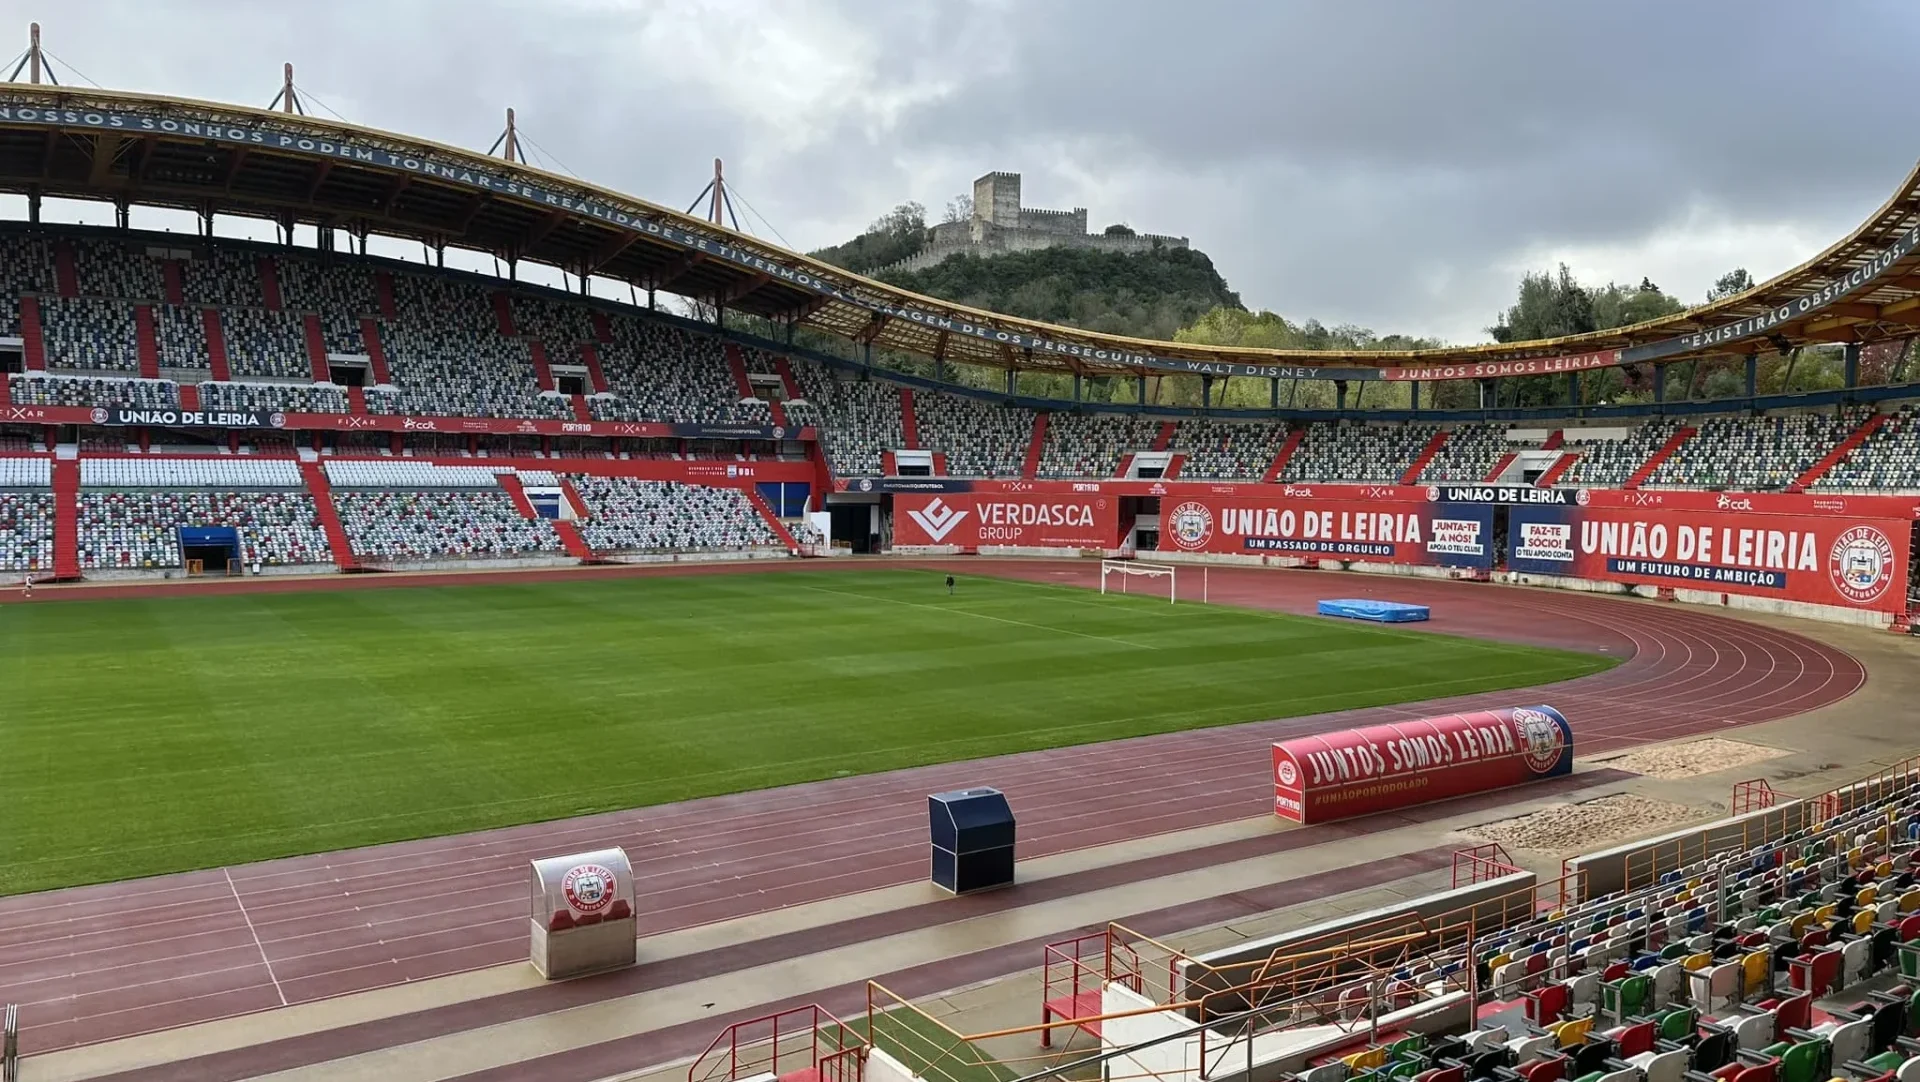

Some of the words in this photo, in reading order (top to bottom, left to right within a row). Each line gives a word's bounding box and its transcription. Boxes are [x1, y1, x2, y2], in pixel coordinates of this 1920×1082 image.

[142, 117, 262, 142] SONHOS
[280, 135, 373, 162] PODEM
[388, 154, 532, 198] TORNAR-SE
[545, 194, 673, 239] REALIDADE
[684, 237, 707, 250] SE
[718, 247, 822, 291] TIVERMOS
[962, 324, 985, 336] DE
[996, 331, 1021, 344] OS
[1187, 361, 1234, 374] WALT
[1247, 365, 1319, 377] DISNEY
[1799, 243, 1905, 312] OBSTÁCULOS.
[1399, 366, 1465, 379] JUNTOS
[1475, 361, 1536, 375] SOMOS
[1544, 354, 1601, 371] LEIRIA
[119, 409, 177, 424] UNIÃO
[182, 411, 204, 425] DE
[208, 412, 260, 426] LEIRIA
[338, 416, 376, 428] FIXAR
[614, 423, 648, 434] FIXAR
[1002, 481, 1033, 492] FIXAR
[1360, 487, 1394, 498] FIXAR
[1448, 488, 1495, 501] UNIÃO
[1499, 489, 1518, 502] DE
[1520, 490, 1566, 504] LEIRIA
[1624, 492, 1662, 506] FIXAR
[1731, 500, 1753, 510] cdt
[976, 502, 1094, 528] VERDASCA
[979, 527, 1023, 540] GROUP
[1222, 508, 1296, 538] UNIÃO
[1303, 511, 1333, 539] DE
[1341, 512, 1421, 544] LEIRIA
[1435, 521, 1478, 532] JUNTA-TE
[1530, 526, 1561, 537] FAZ-TE
[1440, 534, 1447, 542] A
[1449, 533, 1472, 544] NÓS!
[1528, 537, 1562, 549] SÓCIO!
[1581, 520, 1668, 560] UNIÃO
[1677, 525, 1711, 562] DE
[1721, 527, 1818, 572] LEIRIA
[1856, 528, 1869, 539] DE
[1870, 531, 1891, 565] LEIRIA
[1249, 539, 1266, 549] UM
[1269, 540, 1318, 550] PASSADO
[1320, 542, 1335, 552] DE
[1338, 544, 1390, 555] ORGULHO
[1552, 551, 1573, 560] CONTA
[1617, 560, 1637, 572] UM
[1640, 563, 1689, 578] FUTURO
[1695, 568, 1711, 580] DE
[1714, 568, 1775, 586] AMBIÇÃO
[1839, 582, 1880, 599] PORTUGAL
[1306, 743, 1386, 784] JUNTOS
[1387, 734, 1454, 771] SOMOS
[1454, 724, 1516, 759] LEIRIA
[1315, 777, 1428, 806] #UNIÃOPORTODOLADO
